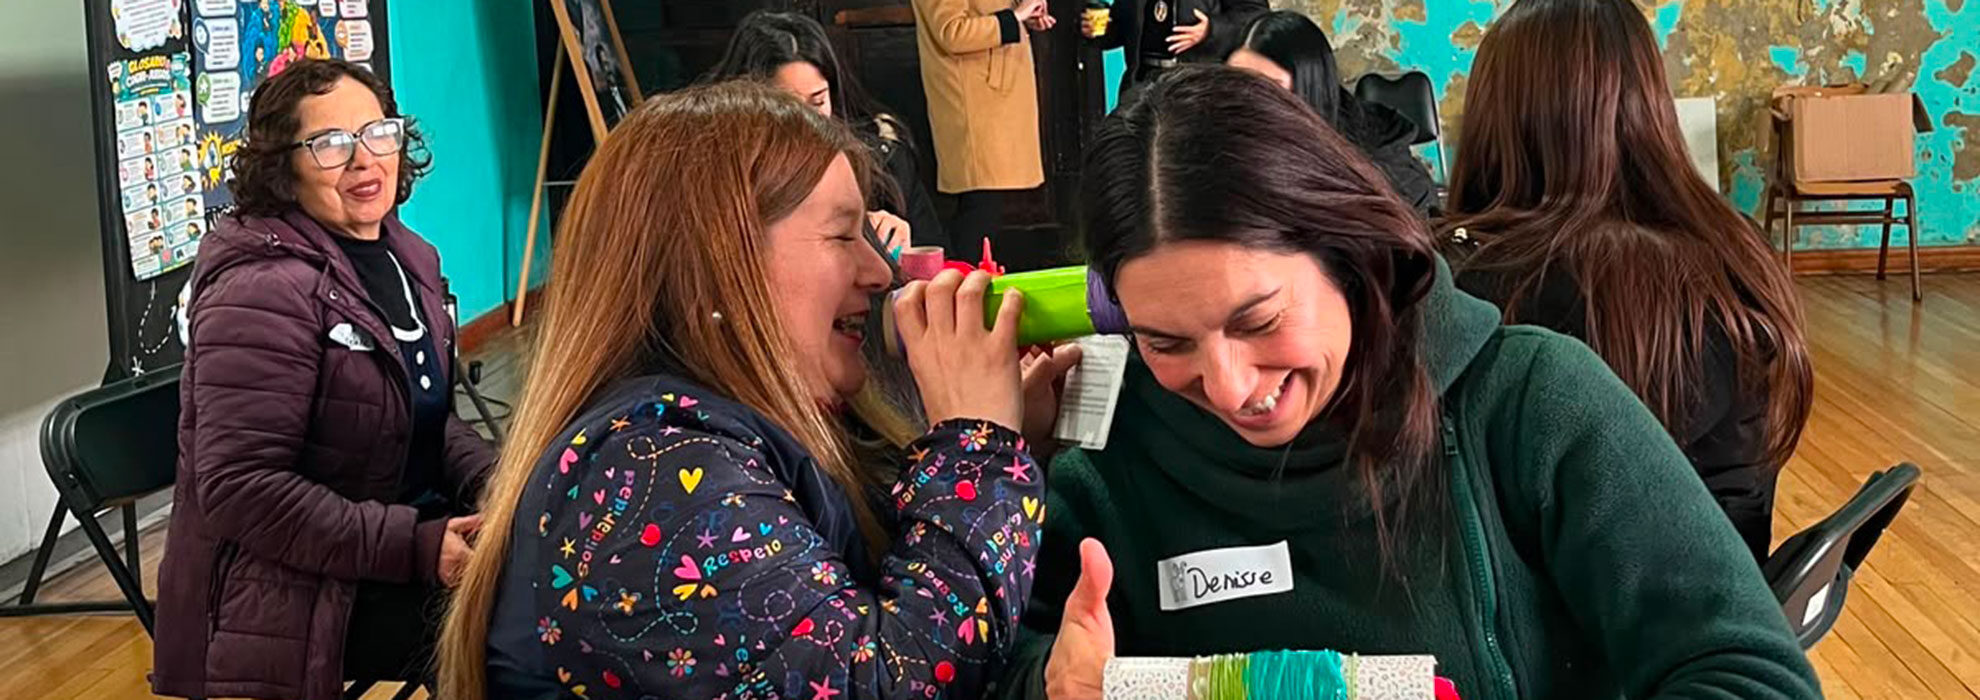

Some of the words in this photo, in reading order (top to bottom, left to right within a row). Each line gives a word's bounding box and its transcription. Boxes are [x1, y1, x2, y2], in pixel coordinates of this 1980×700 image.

[577, 470, 636, 578] Solidaridad
[702, 538, 783, 578] Respeto
[906, 561, 970, 617] Respeto
